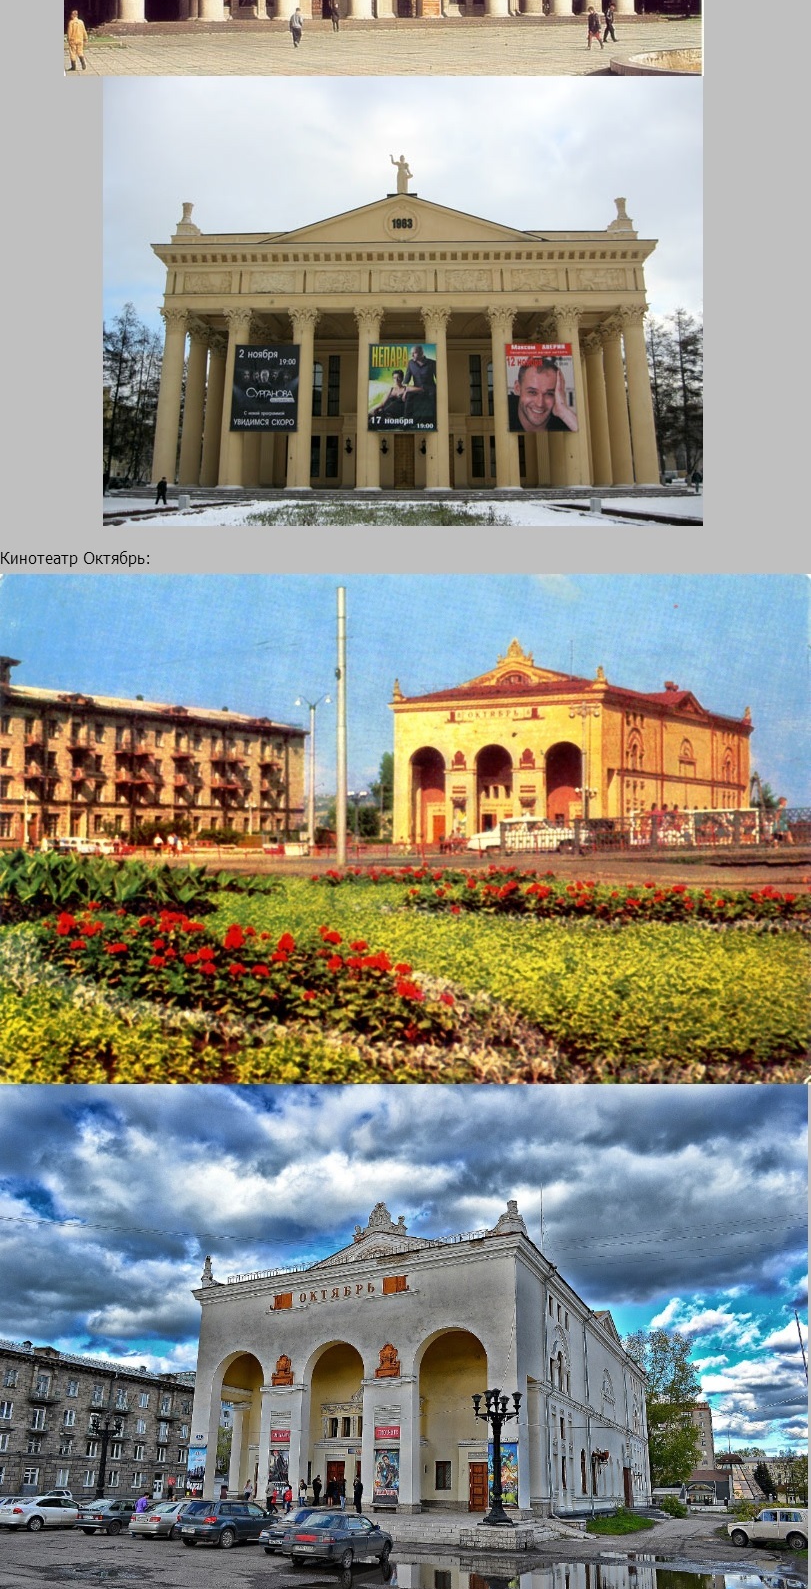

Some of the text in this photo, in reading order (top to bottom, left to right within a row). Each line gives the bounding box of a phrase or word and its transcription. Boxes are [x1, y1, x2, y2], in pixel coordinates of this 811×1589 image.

[238, 349, 278, 361] 2 ноября
[372, 346, 408, 368] НЕПАРА
[279, 358, 297, 366] 19:00
[507, 357, 516, 367] 12
[234, 418, 295, 426] УВИДИМСЯ СКОРО
[371, 416, 414, 426] 17 ноября
[468, 710, 519, 719] ОКТЯБРЬ
[299, 1282, 375, 1303] ОКТЯБРЬ
